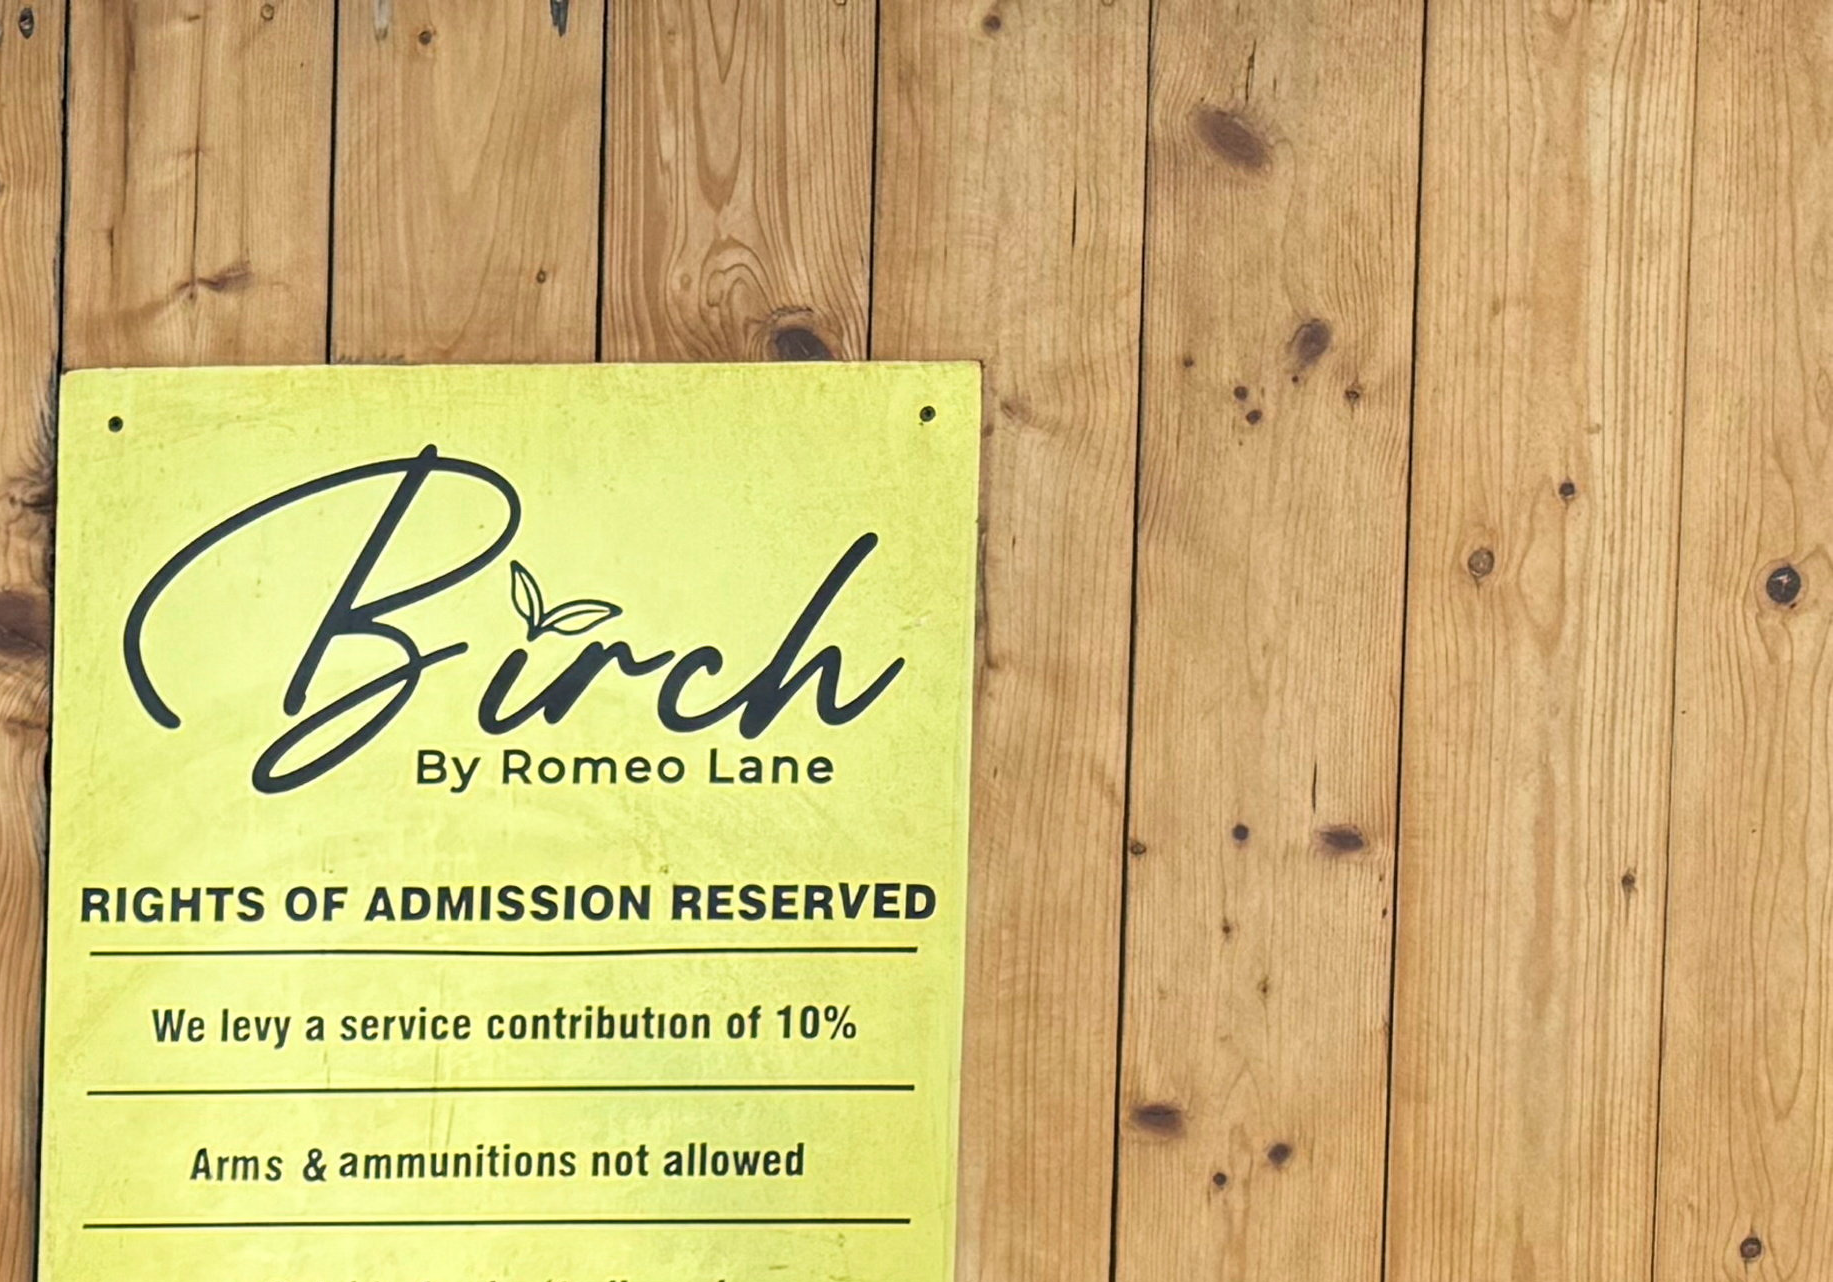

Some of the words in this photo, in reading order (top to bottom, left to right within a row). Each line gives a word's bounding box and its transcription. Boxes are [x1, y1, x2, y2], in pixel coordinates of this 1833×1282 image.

[124, 445, 904, 794] Birch
[416, 748, 482, 794] By
[501, 748, 686, 785] Romeo
[708, 747, 835, 785] Lane
[80, 885, 266, 924] RIGHTS
[284, 885, 349, 923] OF
[363, 883, 652, 923] ADMISSION
[670, 881, 937, 922] RESERVED
[151, 1008, 206, 1043] We
[220, 1007, 292, 1050] levy
[304, 1015, 325, 1042] a
[339, 1005, 472, 1042] service
[486, 1004, 711, 1041] contribution
[726, 1004, 763, 1040] of
[776, 1004, 858, 1041] 10%
[189, 1146, 284, 1182] Arms
[302, 1147, 328, 1183] &
[338, 1142, 577, 1180] ammunitions
[591, 1143, 650, 1178] not
[662, 1141, 805, 1177] allowed
